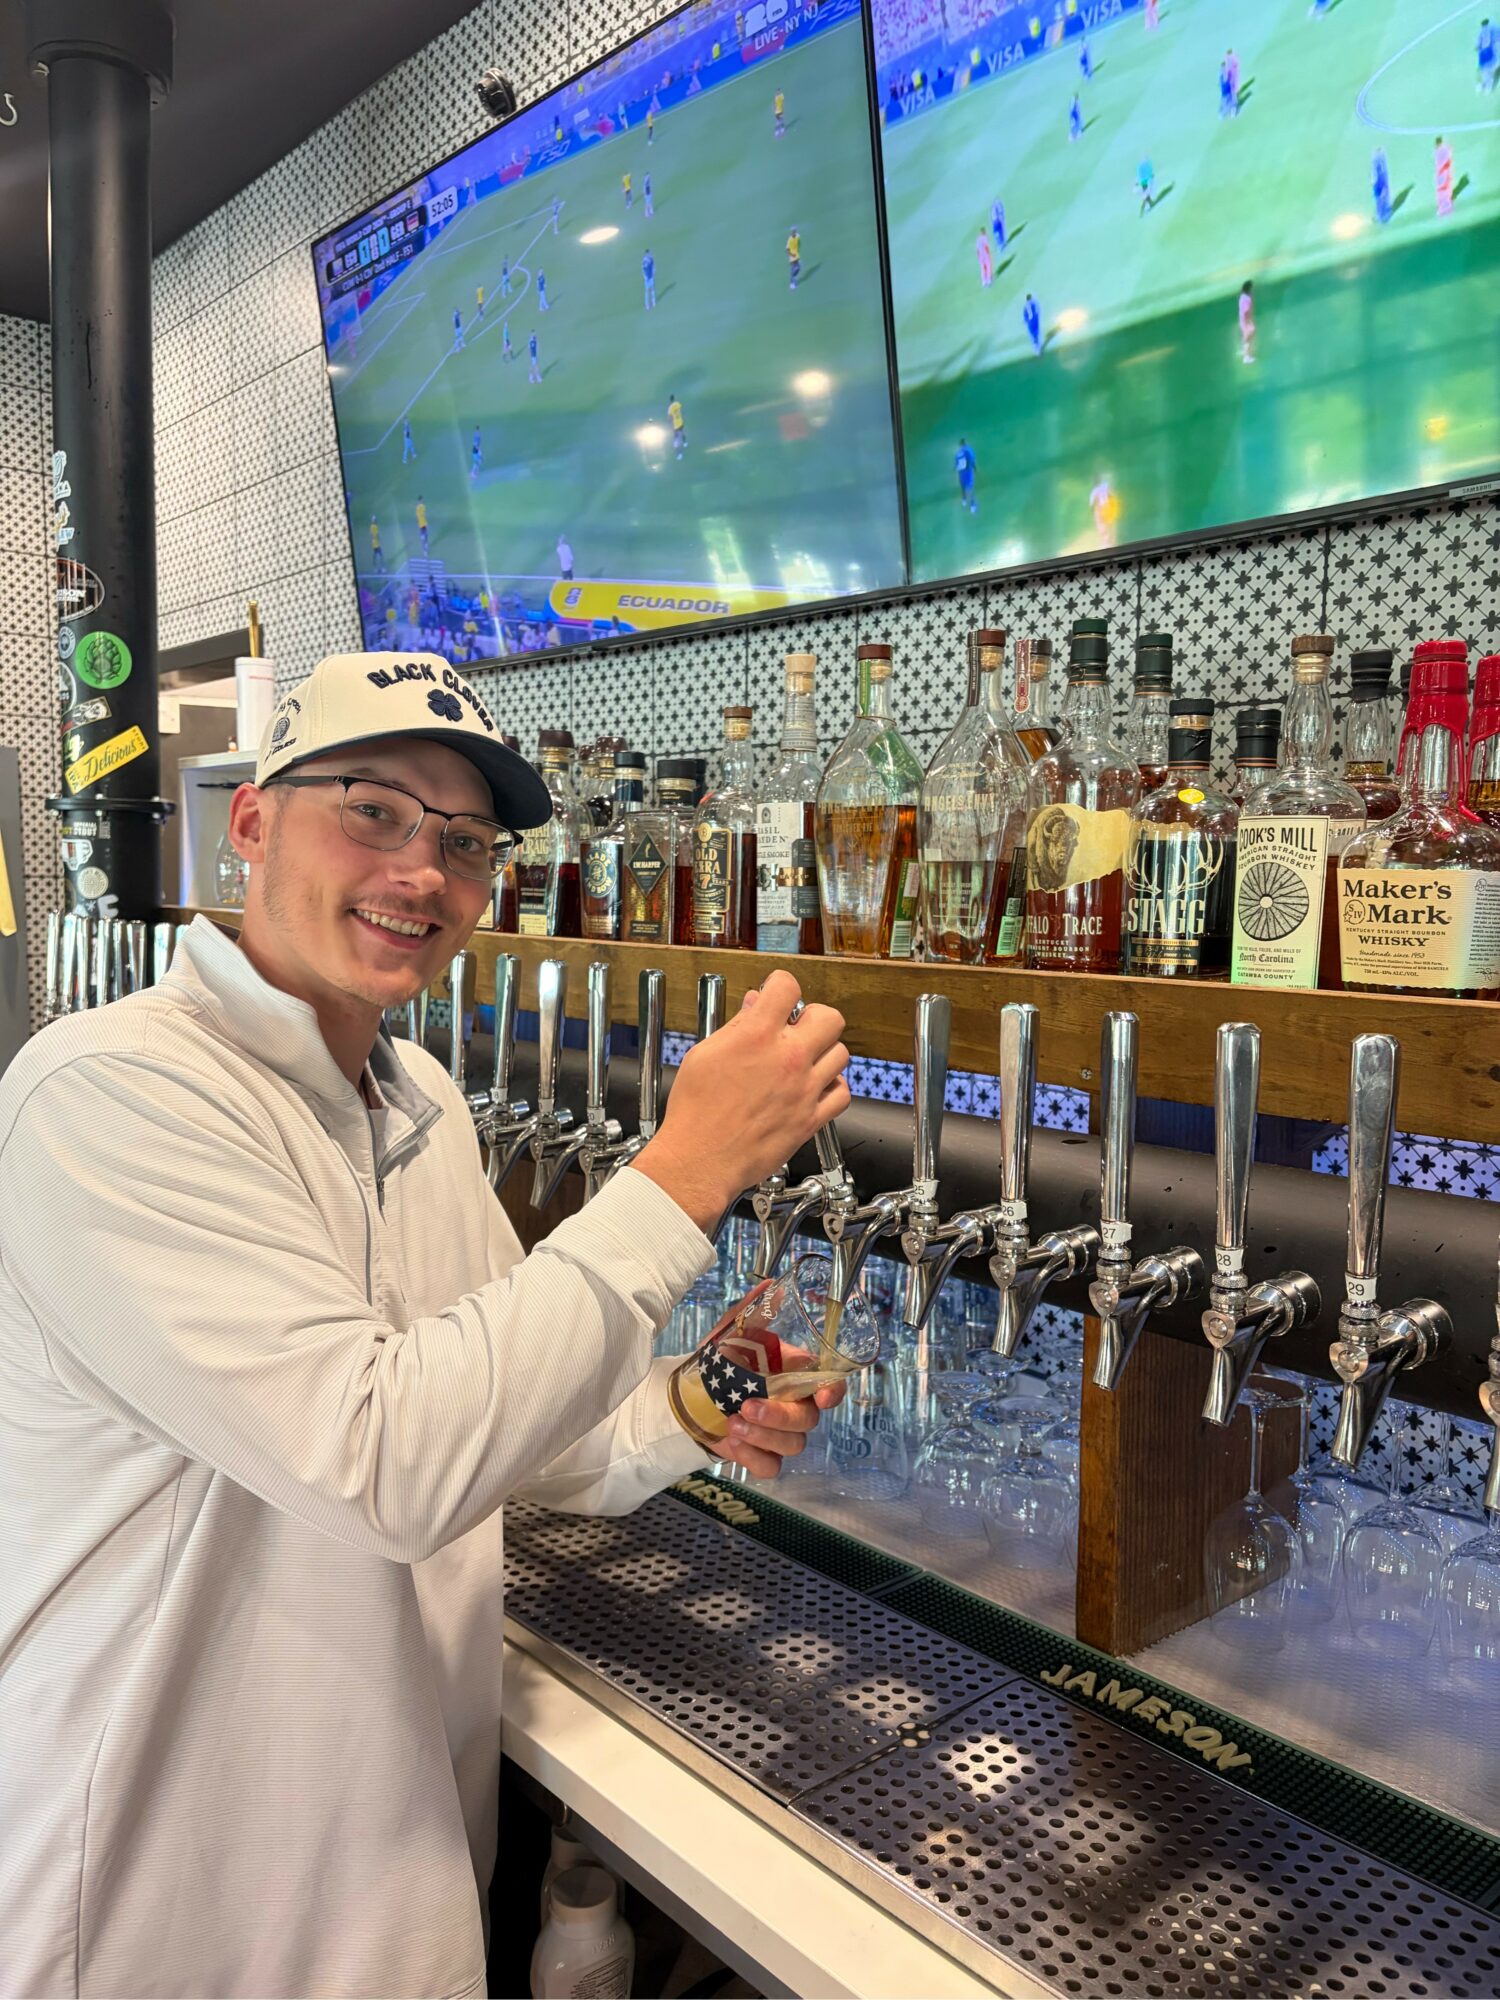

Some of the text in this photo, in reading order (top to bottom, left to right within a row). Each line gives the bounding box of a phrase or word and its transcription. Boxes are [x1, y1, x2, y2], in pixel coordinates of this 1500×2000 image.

[1079, 0, 1123, 28] VISA
[755, 3, 818, 50] LIVE NY NJ
[986, 42, 1025, 74] VISA
[899, 83, 936, 115] VISA
[431, 194, 454, 218] 52:05
[1462, 484, 1492, 494] SAMSUNG
[617, 594, 730, 614] ECUADOR
[367, 663, 494, 732] BLACK CLOVER
[82, 738, 137, 782] Delicious
[1239, 826, 1317, 853] COOK'S MILL
[695, 848, 717, 860] OLD
[1271, 853, 1316, 871] WHISKEY
[1272, 845, 1317, 862] STRAIGHT
[700, 874, 711, 889] 7
[1343, 879, 1452, 899] Maker's
[1127, 897, 1205, 934] STAGG
[1366, 904, 1450, 925] Mark
[1062, 913, 1103, 937] TRACE
[1358, 934, 1430, 947] WHISKY
[1259, 954, 1294, 963] Carolina
[1359, 949, 1391, 957] Handmade
[913, 1183, 925, 1195] 25
[1002, 1205, 1014, 1217] 26
[1102, 1227, 1116, 1240] 27
[1217, 1253, 1232, 1267] 28
[1348, 1281, 1365, 1296] 29
[1040, 1664, 1253, 1772] JAMESON
